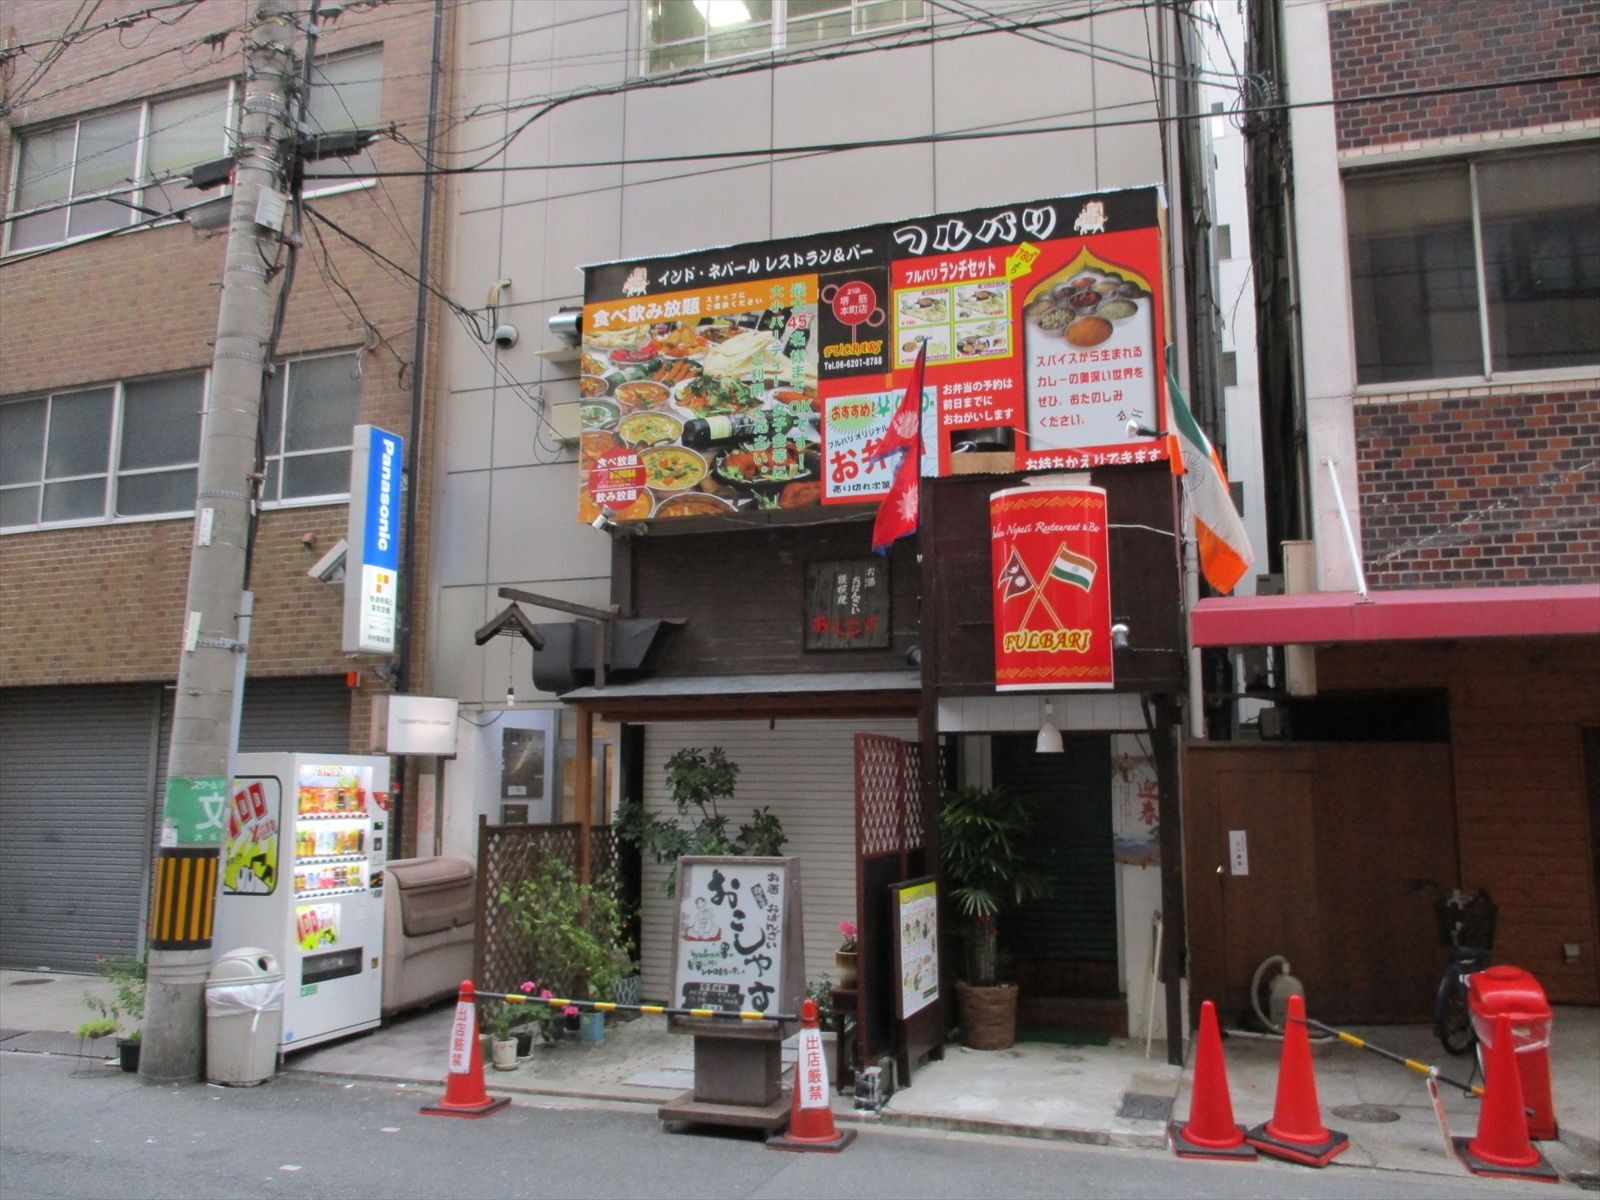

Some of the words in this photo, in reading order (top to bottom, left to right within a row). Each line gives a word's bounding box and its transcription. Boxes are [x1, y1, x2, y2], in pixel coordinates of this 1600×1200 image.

[892, 205, 1056, 255] フルバリ
[939, 260, 996, 280] ランチセット
[592, 296, 701, 328] 食べ飲み放題
[839, 304, 868, 316] 本町店
[823, 340, 883, 358] FULBARI
[1036, 346, 1143, 367] スパイスから生まれる
[942, 377, 1014, 395] お弁当の予約は
[1036, 367, 1144, 388] カレーの奥深い世界を
[943, 395, 993, 411] 前日までに
[943, 408, 1014, 425] おねがいします
[597, 454, 638, 469] 食べ放題
[377, 437, 395, 551] Panasonic
[596, 489, 637, 503] 飲み放題
[1004, 629, 1092, 654] FULBARI
[195, 792, 226, 830] 文
[706, 868, 776, 1013] おこしやす
